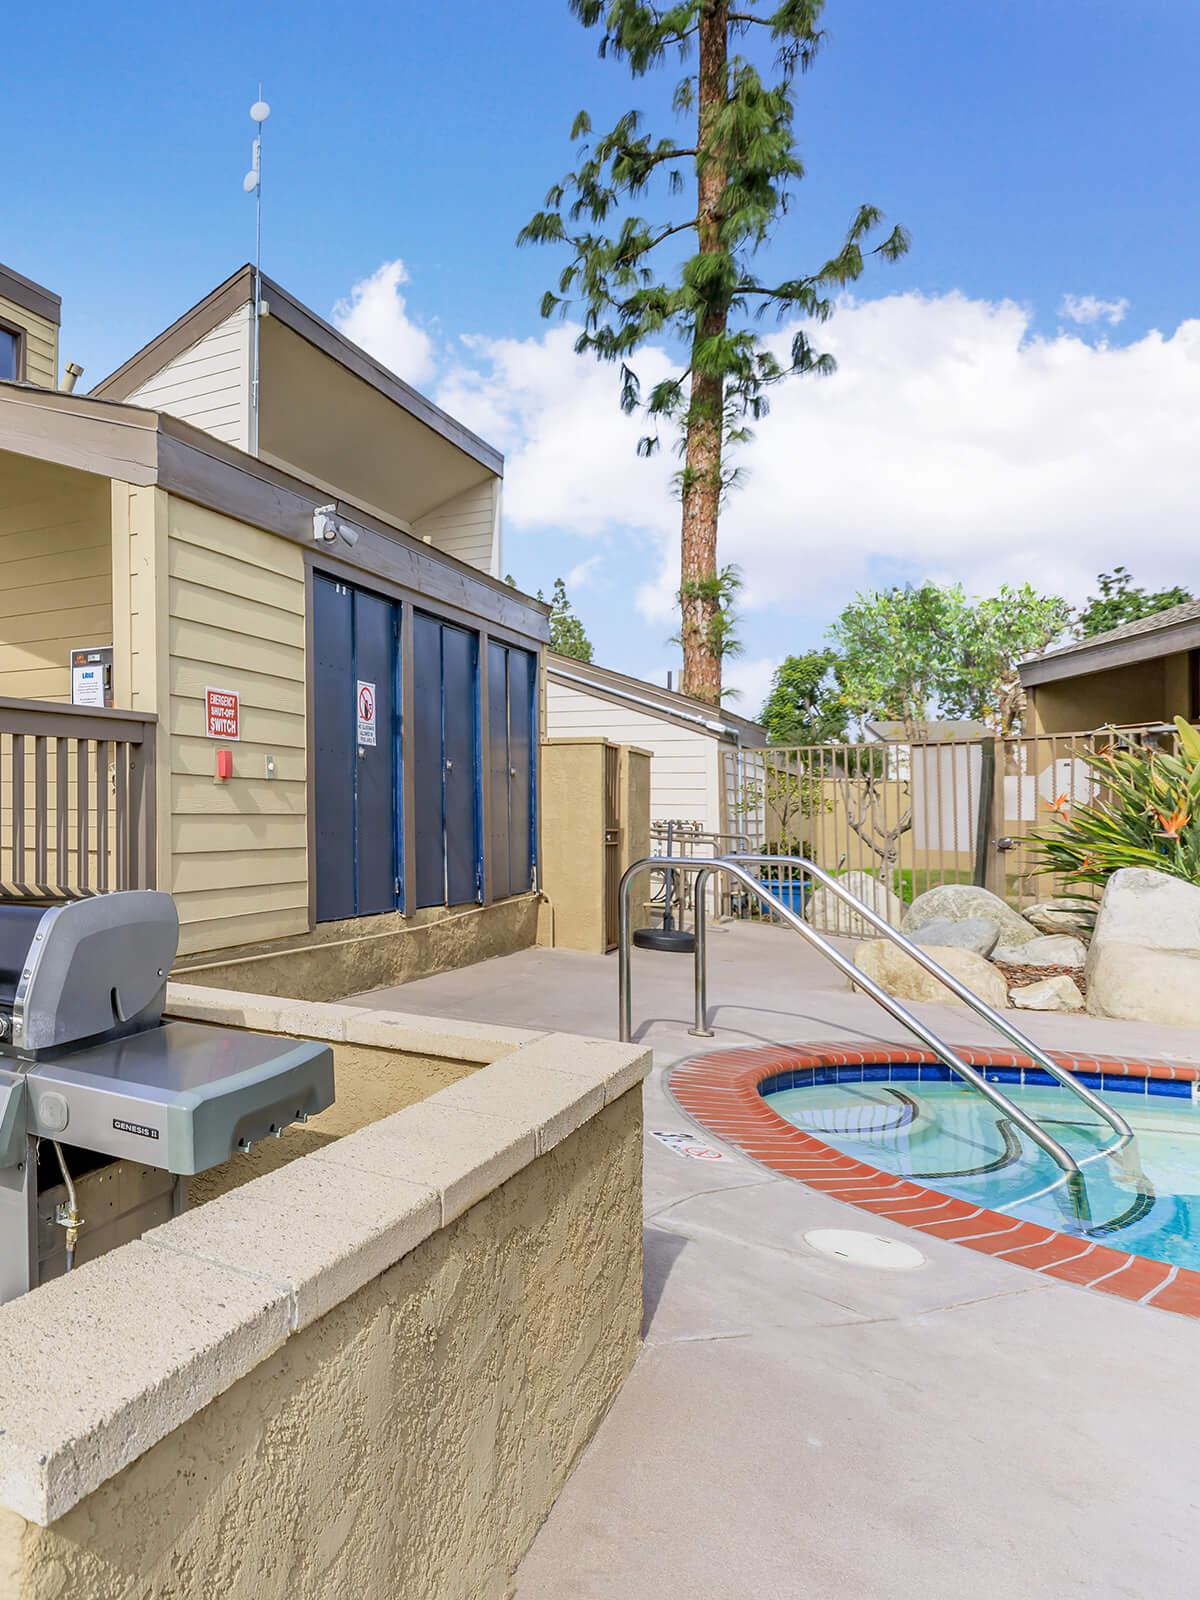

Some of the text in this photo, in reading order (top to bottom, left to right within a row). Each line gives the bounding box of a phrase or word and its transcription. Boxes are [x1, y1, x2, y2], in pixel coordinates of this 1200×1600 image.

[210, 693, 235, 708] EMERGENCY
[211, 706, 234, 718] SHUT-OFF
[210, 717, 236, 734] SWITCH
[114, 1121, 149, 1136] GENESIS
